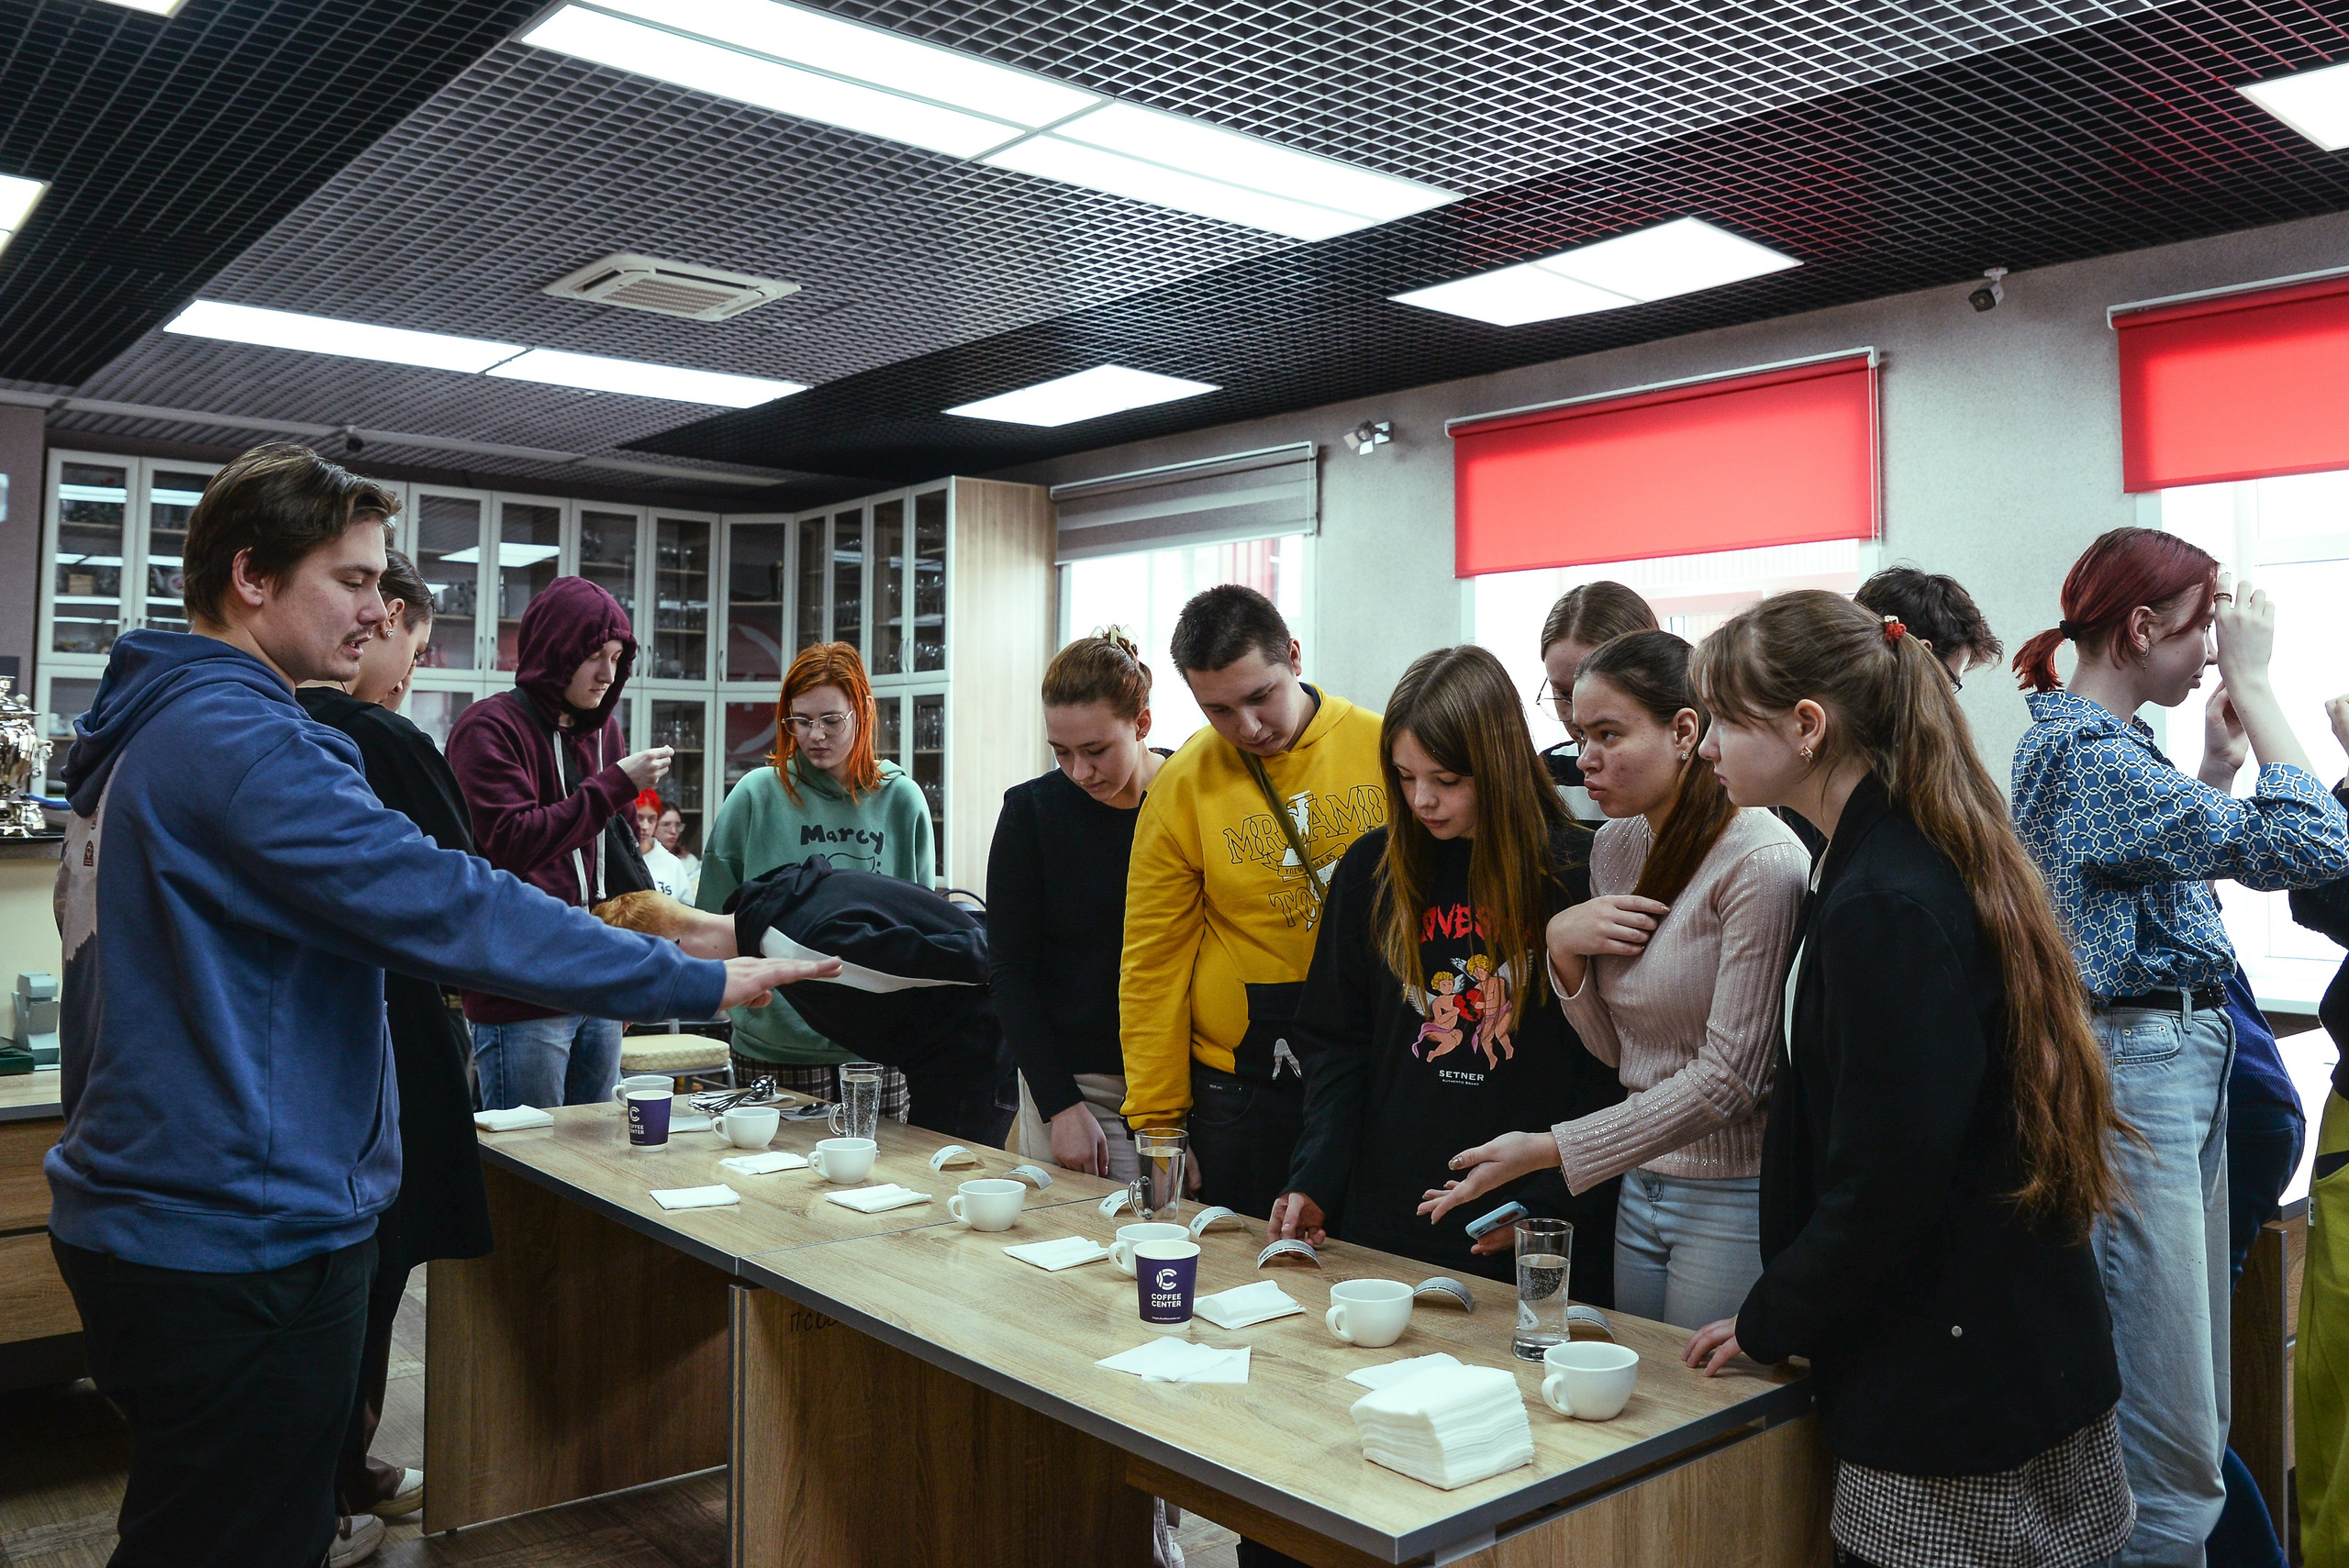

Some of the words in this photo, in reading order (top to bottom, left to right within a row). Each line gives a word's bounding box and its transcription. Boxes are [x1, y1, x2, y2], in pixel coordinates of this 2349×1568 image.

[800, 824, 884, 855] Marcy
[1439, 1069, 1485, 1082] SETNER
[1151, 1293, 1182, 1301] COFFEE
[1151, 1300, 1182, 1308] CENTER
